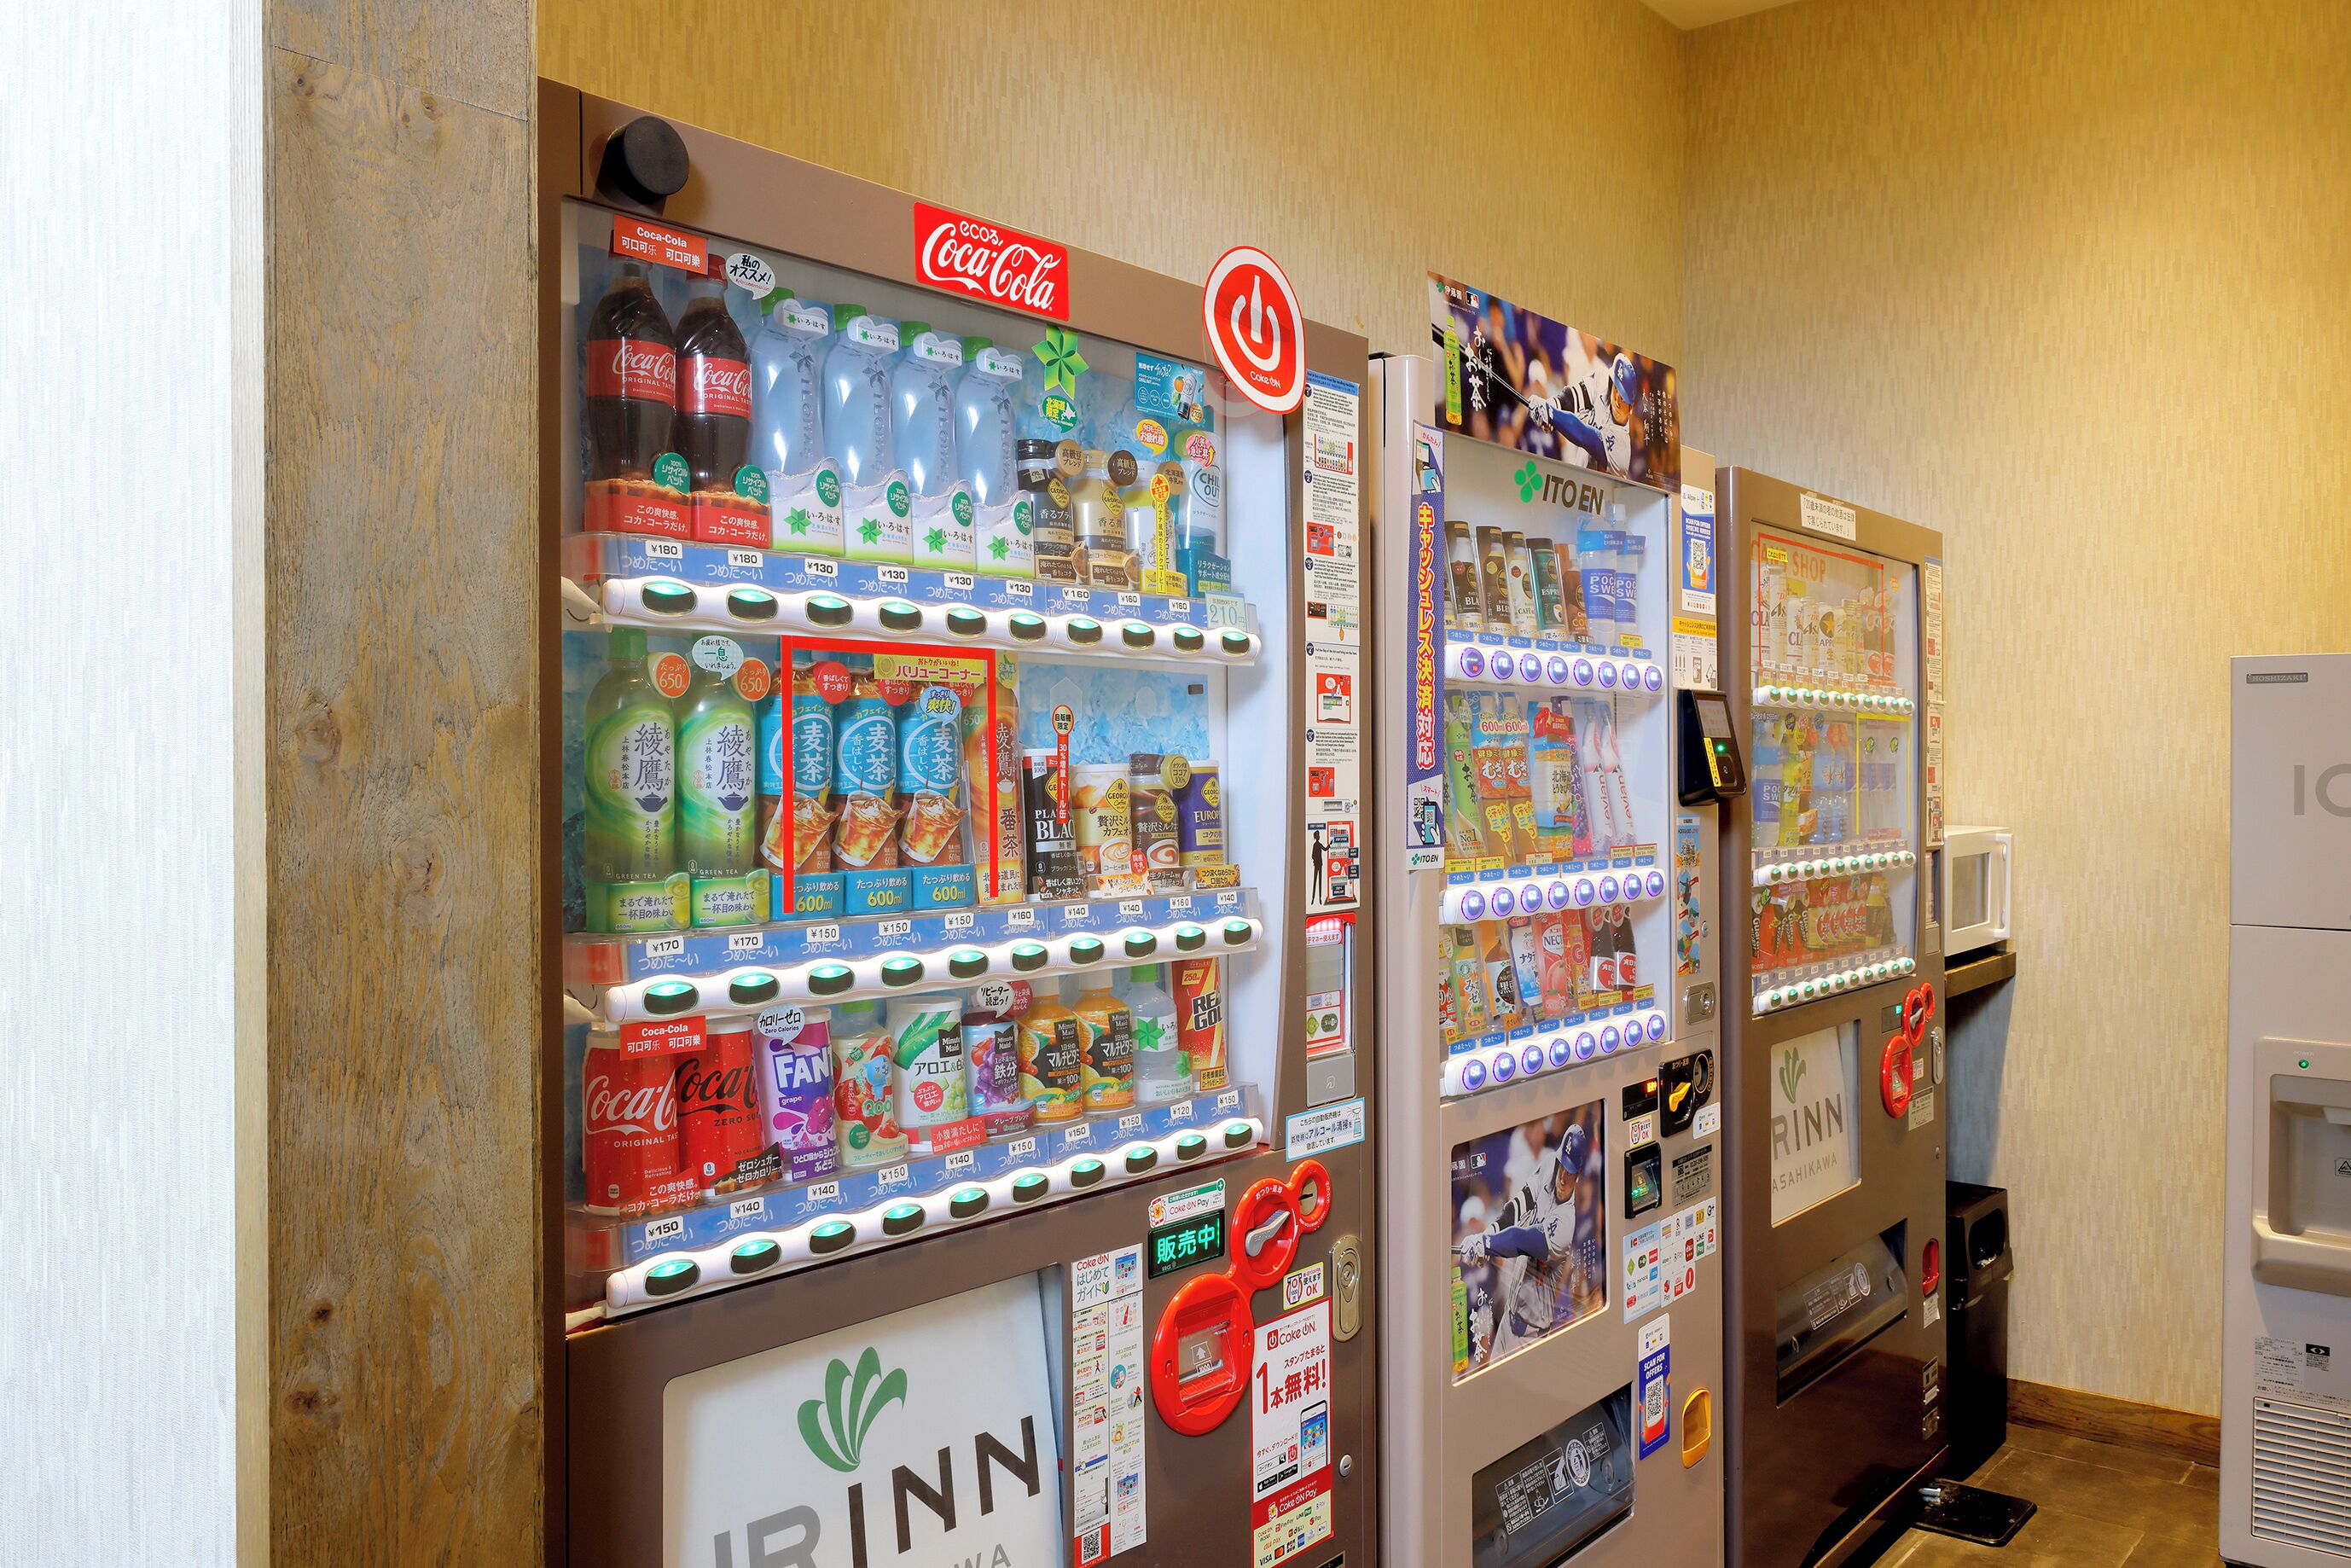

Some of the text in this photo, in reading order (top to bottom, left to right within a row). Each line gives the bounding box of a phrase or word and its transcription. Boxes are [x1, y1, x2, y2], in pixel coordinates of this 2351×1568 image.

[637, 226, 688, 248] Coca-Cola
[621, 236, 701, 268] 可口可乐 可口可樂
[741, 255, 761, 270] 私の
[922, 223, 1062, 310] Coca-Cola
[1250, 370, 1269, 385] Coke
[704, 393, 740, 403] ORIGINAL
[662, 465, 688, 478] リサイクル
[742, 476, 766, 489] リサイクル
[1542, 474, 1605, 515] ITO EN
[651, 543, 678, 556] ¥180
[732, 553, 758, 565] ¥180
[808, 561, 834, 575] ¥130
[1793, 551, 1826, 583] SHOP
[881, 569, 906, 581] ¥130
[949, 575, 972, 587] ¥130
[1009, 583, 1031, 594] ¥130
[1064, 589, 1090, 600] ¥160
[1120, 595, 1139, 604] ¥160
[1171, 601, 1188, 611] ¥160
[704, 646, 729, 662] 一息
[660, 662, 687, 672] たっぷり
[896, 665, 981, 681] バリューコーナー
[2252, 674, 2303, 682] HOSHIZAKI
[822, 682, 849, 692] すっきり
[927, 696, 955, 714] 爽快!
[634, 722, 668, 792] 綾鷹
[717, 724, 748, 792] 綾鷹
[798, 721, 827, 782] 麦茶
[864, 723, 891, 782] 麦茶
[930, 727, 956, 781] 麦茶
[1000, 807, 1019, 858] 番茶
[856, 877, 908, 889] たっぷり飲める
[923, 872, 971, 885] たっぷり飲める
[867, 891, 903, 907] 600ml
[932, 886, 966, 902] 600ml
[1220, 893, 1235, 903] ¥140
[796, 896, 833, 912] 600ml
[1123, 903, 1141, 913] ¥140
[1172, 898, 1189, 907] ¥160
[1012, 911, 1031, 920] ¥160
[1067, 907, 1086, 916] ¥140
[882, 922, 908, 933] ¥150
[948, 915, 971, 926] ¥150
[810, 927, 837, 939] ¥150
[652, 939, 680, 953] ¥170
[733, 936, 758, 947] ¥170
[1193, 986, 1222, 1014] REA
[759, 1010, 801, 1027] カロリーゼロ
[1194, 1008, 1222, 1031] GOL
[641, 1024, 688, 1037] Coca-Cola
[777, 1025, 799, 1033] Calories
[627, 1033, 701, 1053] 可口可乐 可口可樂
[945, 1044, 960, 1054] Maid
[994, 1062, 1018, 1079] 鉄分
[781, 1095, 803, 1105] grape
[862, 1099, 892, 1116] Qoo
[1172, 1106, 1190, 1116] ¥120
[714, 1116, 743, 1127] ZERO
[738, 1155, 780, 1171] ゼロシュガー
[880, 1167, 906, 1181] ¥150
[1772, 1153, 1837, 1193] ASAHIKAWA
[649, 1176, 698, 1195] この爽快感。
[811, 1184, 835, 1197] ¥140
[734, 1201, 760, 1213] ¥140
[1198, 1198, 1210, 1209] Pay
[648, 1221, 679, 1237] ¥150
[1157, 1224, 1215, 1264] 販売中
[1077, 1258, 1096, 1271] Coke
[1077, 1266, 1109, 1286] はじめて
[1077, 1282, 1102, 1303] ガイド
[1306, 1283, 1318, 1297] OK
[1280, 1329, 1301, 1345] Coke
[1284, 1344, 1325, 1369] スタンプたまると
[1644, 1351, 1665, 1372] SCAN FOR
[1646, 1363, 1663, 1380] OFFERS
[1256, 1358, 1326, 1414] 1本無料!
[1280, 1499, 1295, 1513] Coke
[1305, 1488, 1317, 1500] Pay
[1259, 1554, 1273, 1566] VISA
